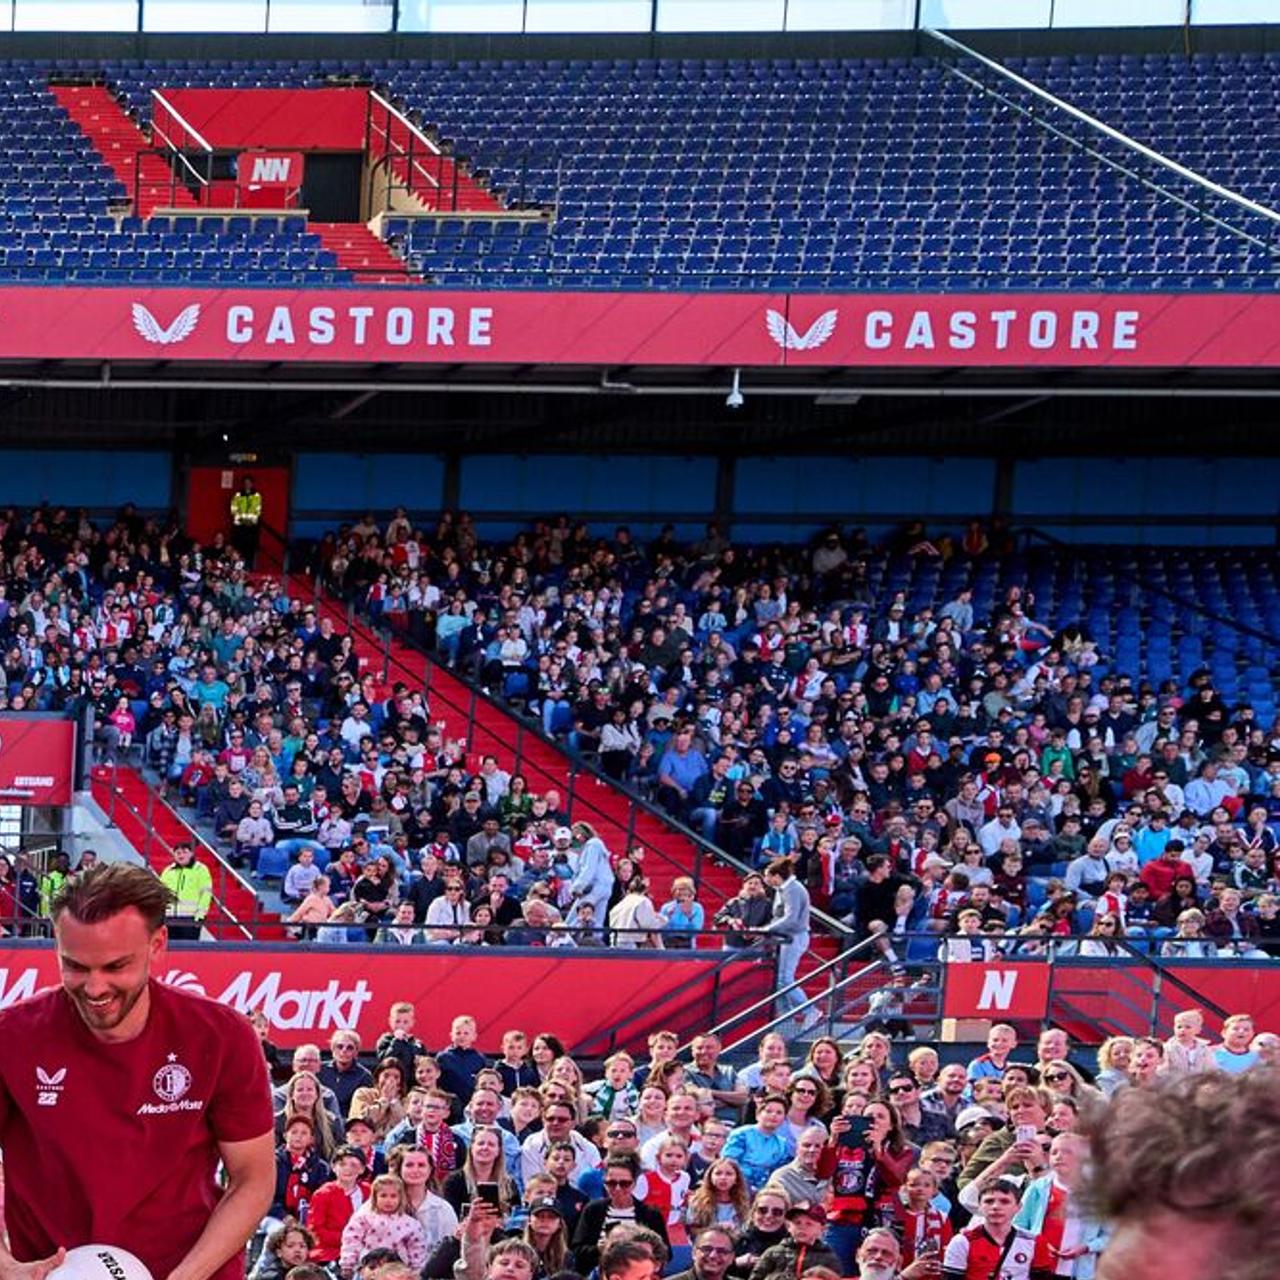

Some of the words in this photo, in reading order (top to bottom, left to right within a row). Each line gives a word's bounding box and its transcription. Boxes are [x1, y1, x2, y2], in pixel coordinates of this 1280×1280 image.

[251, 158, 291, 182] NN
[226, 305, 493, 346] CASTORE
[864, 310, 1139, 349] CASTORE
[976, 970, 1018, 1010] N
[37, 1091, 58, 1106] 22
